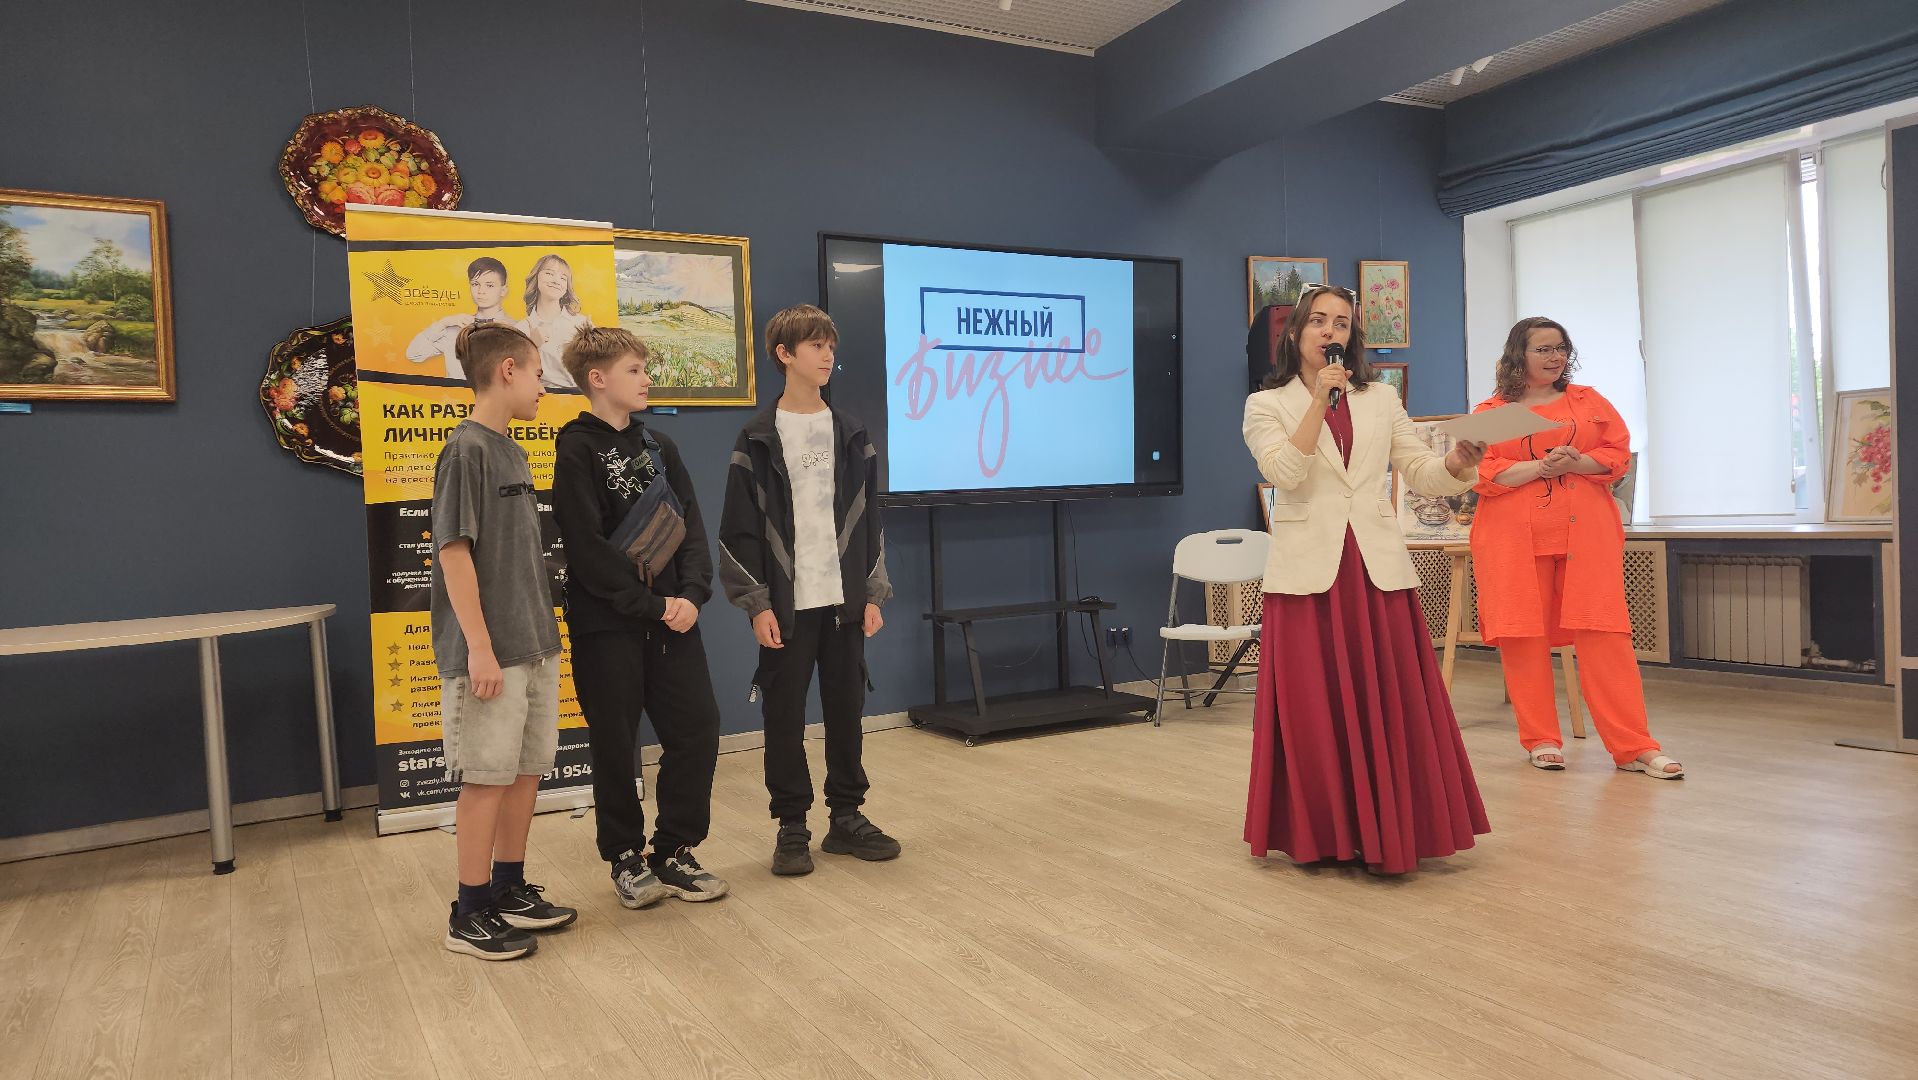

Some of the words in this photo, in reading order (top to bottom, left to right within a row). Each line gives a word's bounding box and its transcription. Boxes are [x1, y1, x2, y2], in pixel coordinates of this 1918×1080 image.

[957, 305, 1053, 337] НЕЖНЫЙ
[383, 403, 425, 419] КАК
[400, 507, 429, 517] Если
[404, 624, 430, 635] Для
[398, 756, 446, 772] stars
[562, 763, 593, 778] 954
